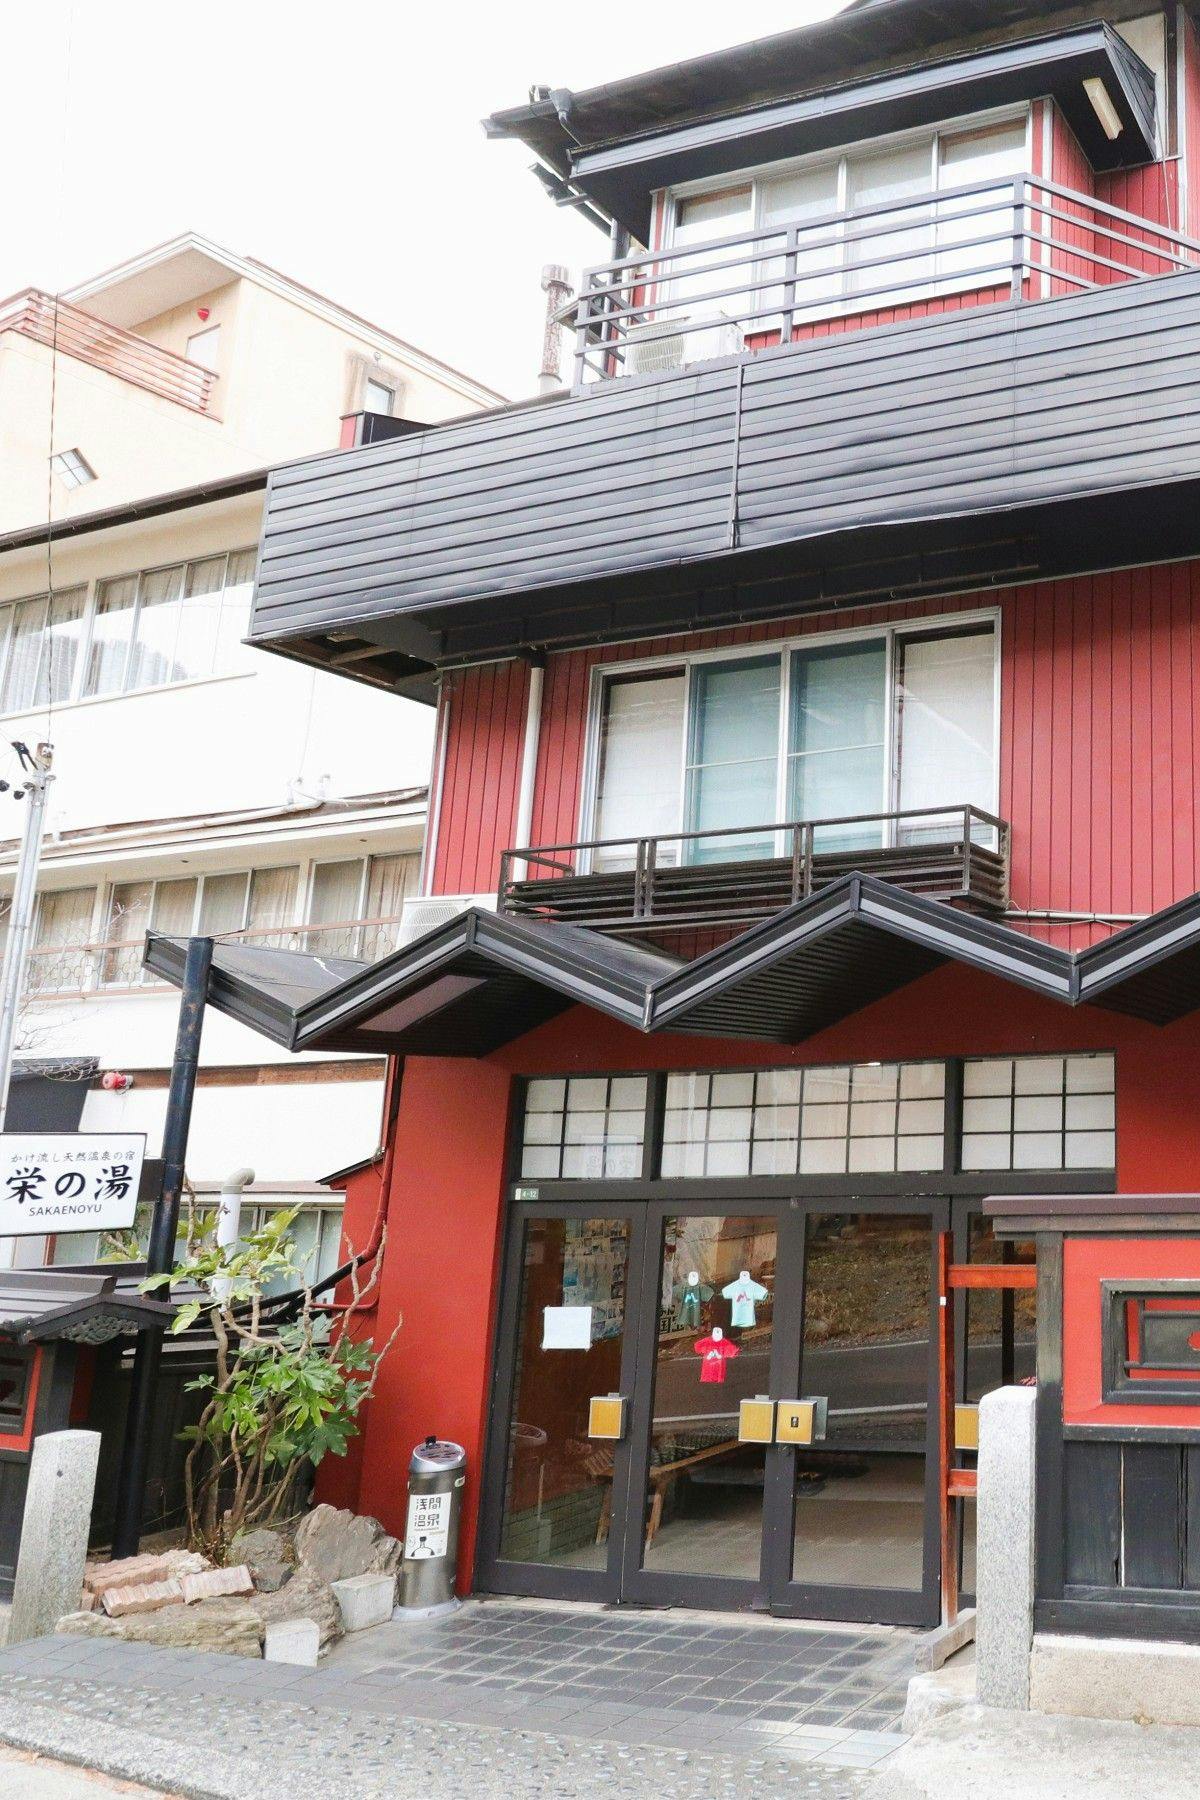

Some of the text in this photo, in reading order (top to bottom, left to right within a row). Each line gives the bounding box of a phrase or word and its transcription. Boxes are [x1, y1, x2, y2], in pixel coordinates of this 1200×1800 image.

[4, 1164, 133, 1204] 栄の湯
[29, 1205, 102, 1216] SAKAENOYU
[415, 1496, 442, 1511] 浅間
[414, 1513, 440, 1527] 温泉
